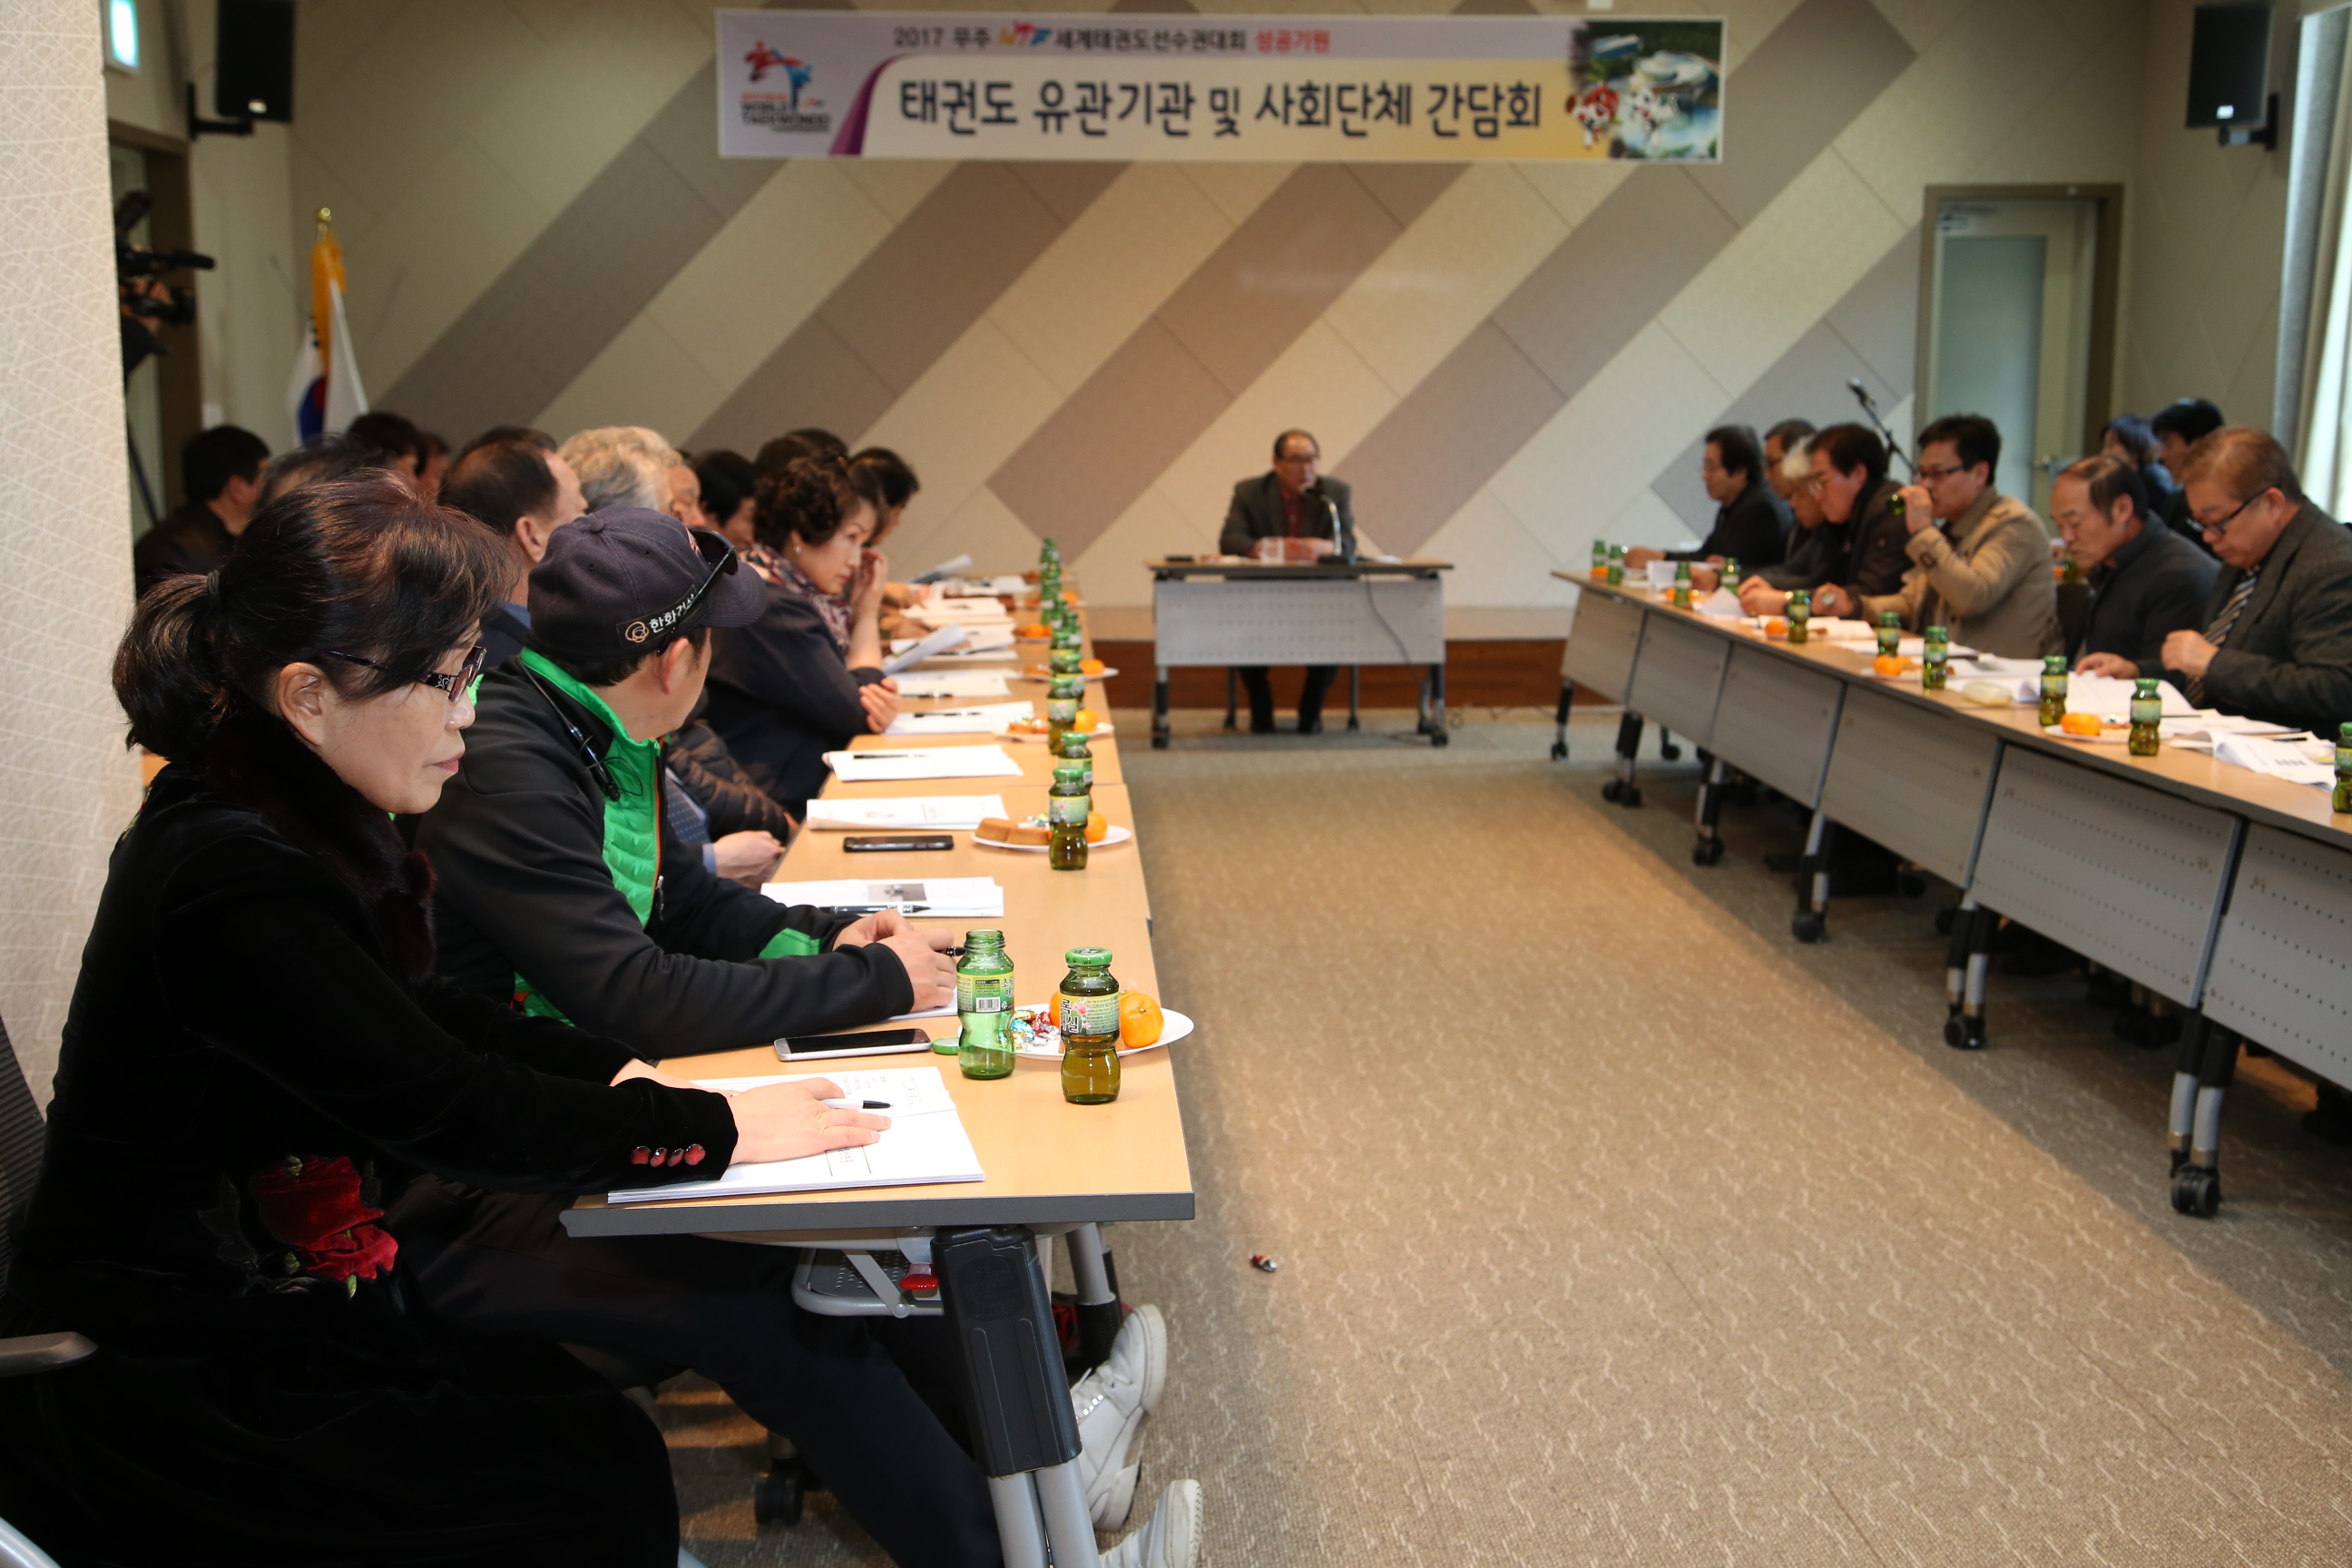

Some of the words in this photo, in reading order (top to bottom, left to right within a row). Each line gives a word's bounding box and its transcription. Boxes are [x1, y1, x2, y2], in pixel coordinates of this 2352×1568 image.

[894, 26, 945, 46] 2017
[955, 26, 991, 48] 무주
[1056, 28, 1247, 53] 세계태권도선수권대회
[1256, 29, 1331, 53] 성공기원
[899, 81, 1018, 134] 태권도
[1033, 81, 1196, 137] 유관기관
[1210, 86, 1241, 137] 및
[1254, 82, 1412, 137] 사회단체
[1426, 83, 1542, 138] 간담회
